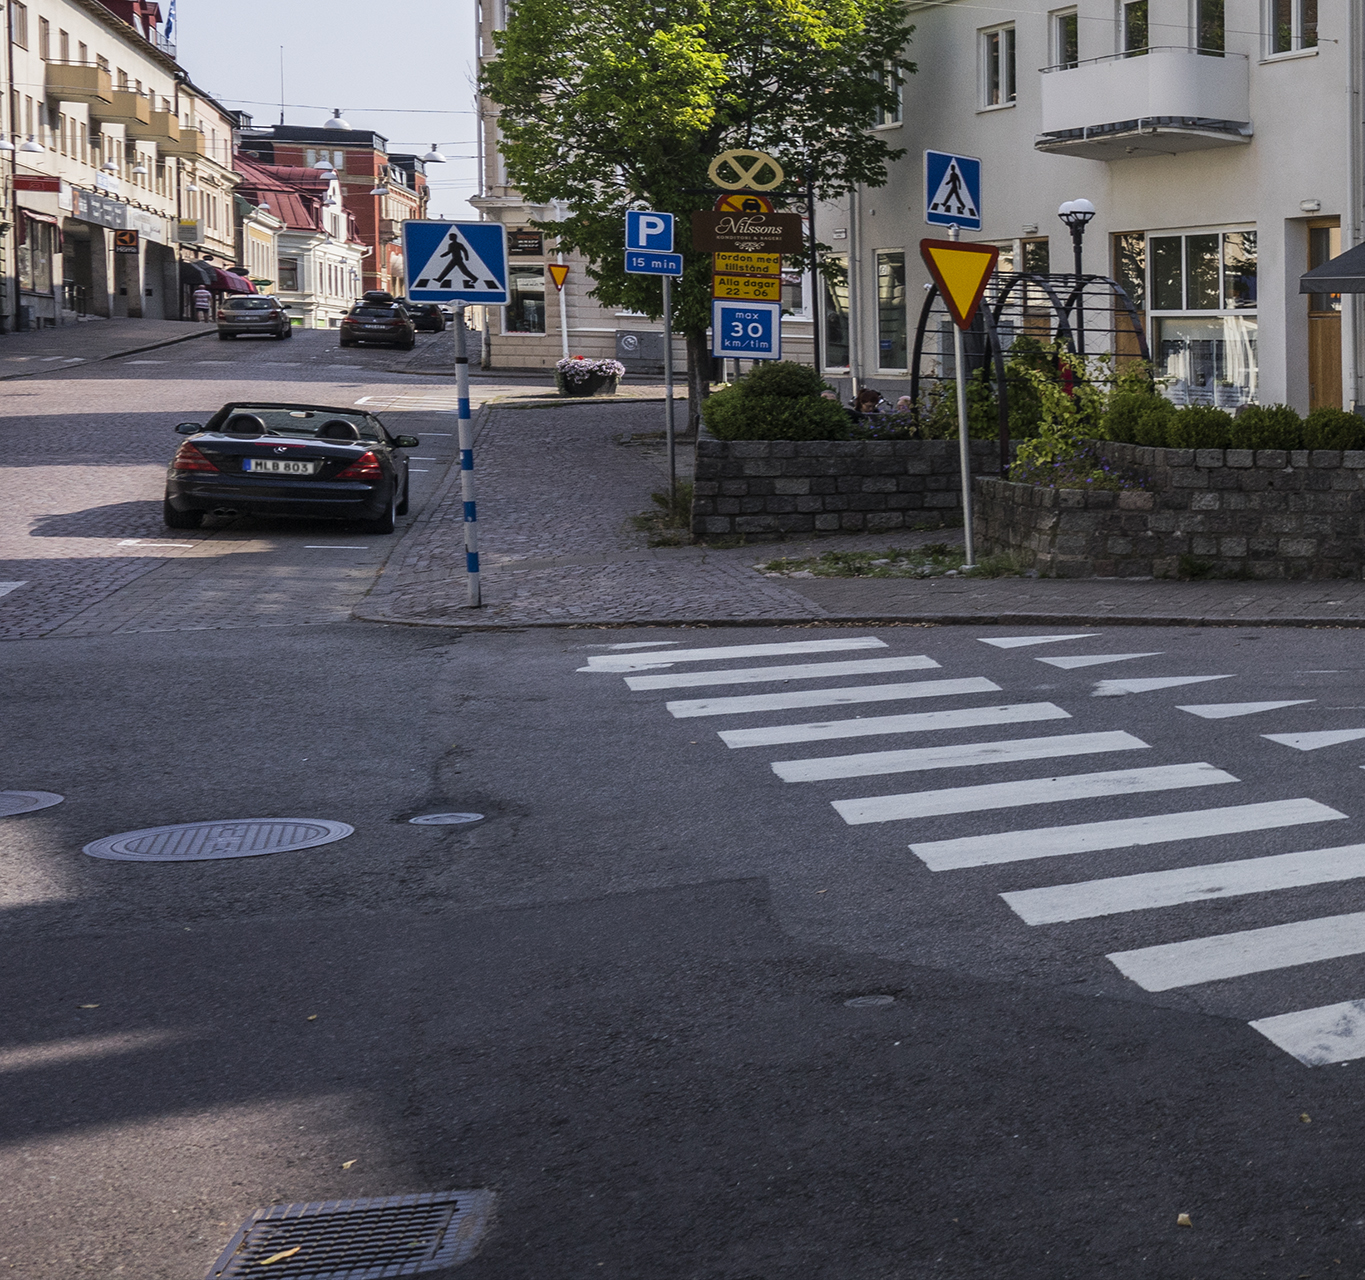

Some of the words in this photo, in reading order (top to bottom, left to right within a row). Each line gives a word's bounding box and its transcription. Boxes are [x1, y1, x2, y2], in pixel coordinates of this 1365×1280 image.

[715, 214, 783, 234] Nilssons
[638, 215, 665, 247] P
[632, 257, 645, 267] 15
[651, 258, 676, 269] min
[716, 253, 753, 262] fordon
[756, 256, 779, 264] med
[725, 263, 769, 273] tillstånd
[718, 277, 740, 287] Alla
[743, 278, 776, 289] dagar
[726, 287, 740, 296] 22
[753, 288, 769, 297] 06
[735, 311, 759, 320] max
[731, 321, 763, 338] 30
[724, 339, 769, 349] km/tim
[254, 461, 280, 471] MLB
[283, 462, 309, 473] 803
